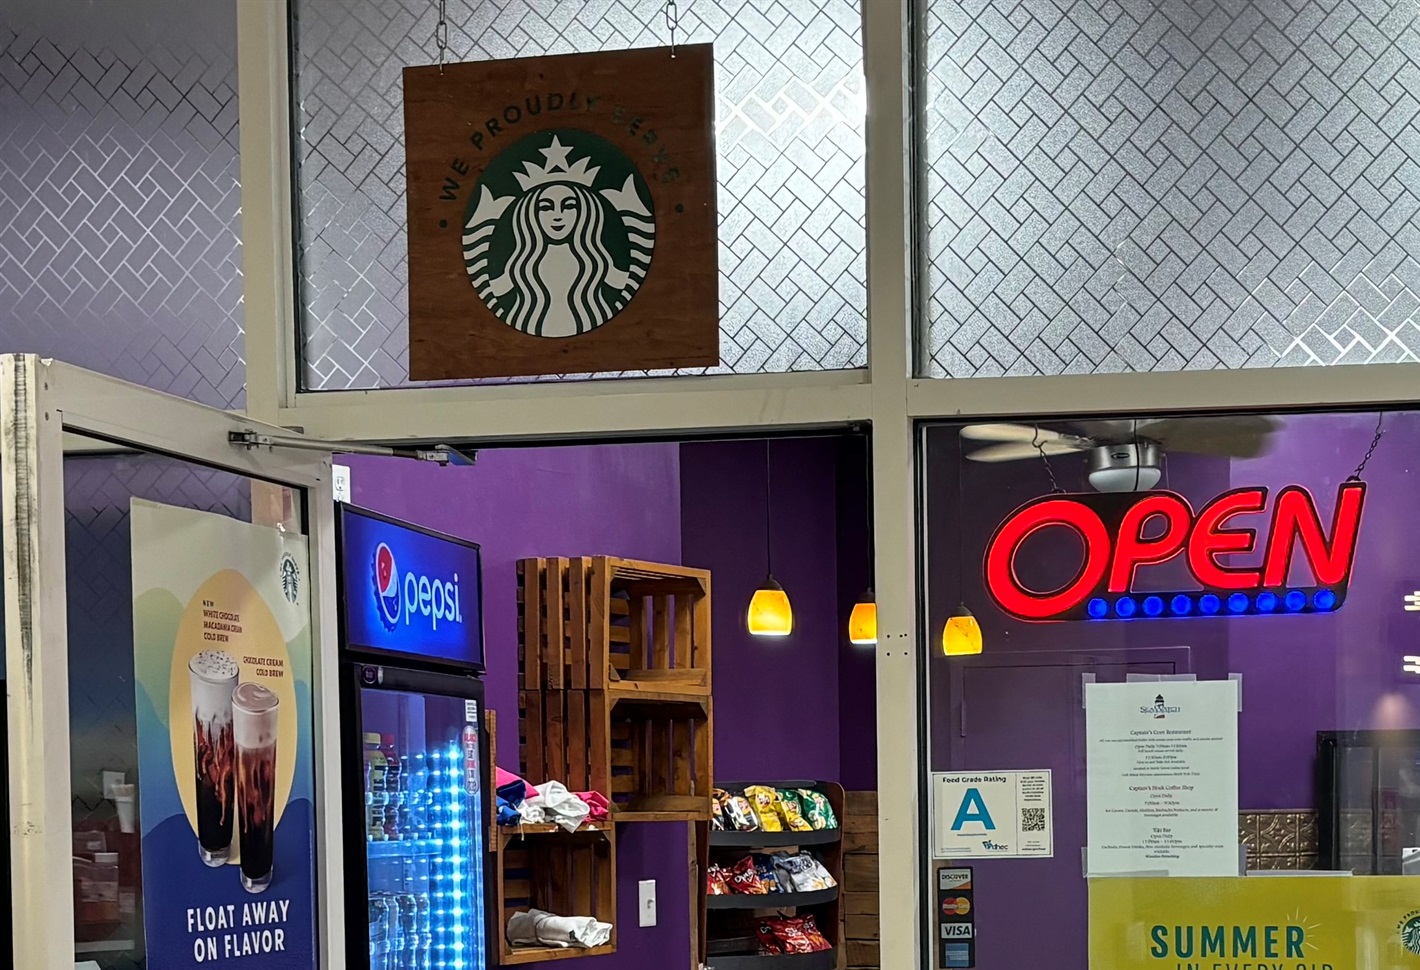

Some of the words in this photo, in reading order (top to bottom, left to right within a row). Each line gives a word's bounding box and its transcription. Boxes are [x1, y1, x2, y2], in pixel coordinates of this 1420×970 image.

[439, 158, 470, 201] WE
[469, 91, 599, 151] PROUDLY
[986, 485, 1365, 618] OPEN
[404, 572, 460, 631] pepsi
[204, 632, 216, 641] COLD
[217, 633, 229, 642] BREW
[243, 656, 266, 665] CHOCOLATE
[266, 658, 284, 667] CREAM
[256, 668, 268, 677] COLD
[269, 669, 284, 677] BREW
[983, 775, 1007, 783] Rating
[950, 788, 996, 831] A
[187, 904, 235, 933] FLOAT
[242, 899, 290, 927] AWAY
[944, 925, 971, 936] VISA
[194, 936, 218, 962] ON
[224, 928, 286, 959] FLAVOR
[1151, 924, 1305, 958] SUMMER
